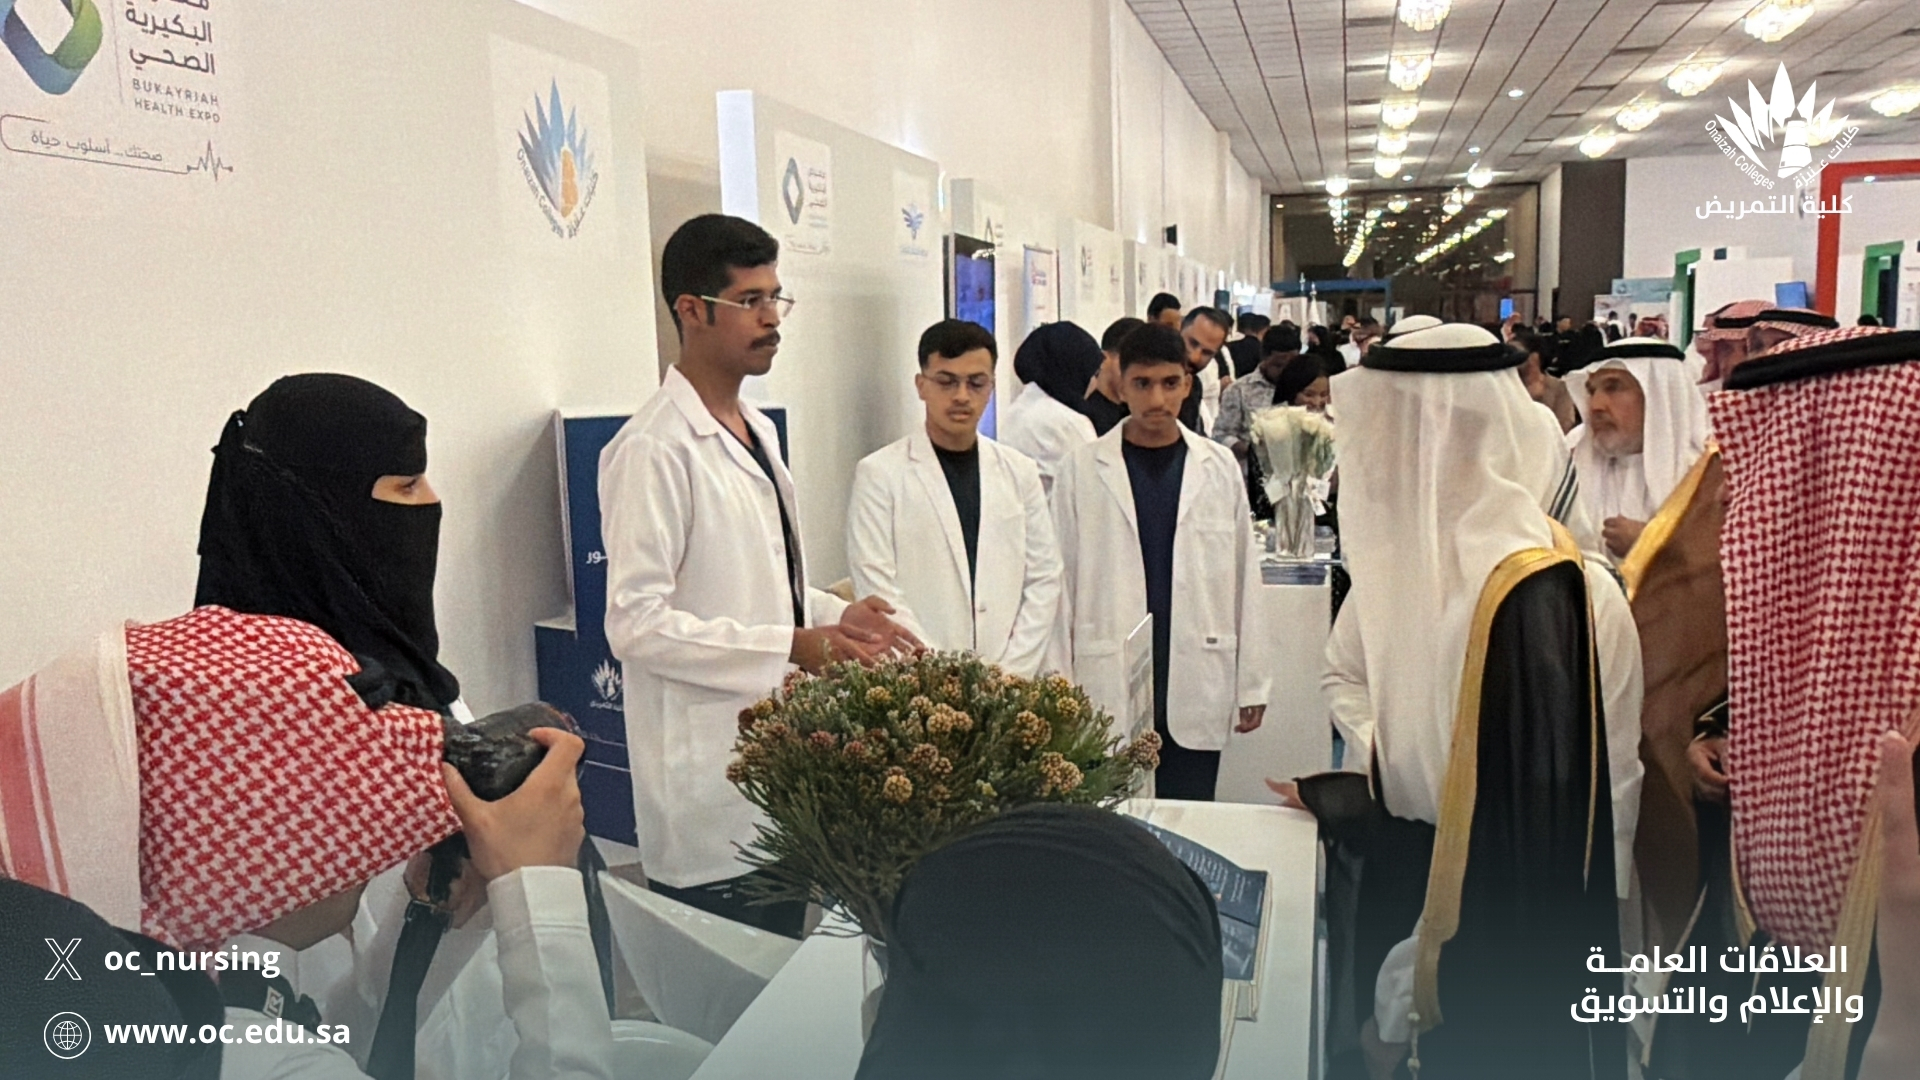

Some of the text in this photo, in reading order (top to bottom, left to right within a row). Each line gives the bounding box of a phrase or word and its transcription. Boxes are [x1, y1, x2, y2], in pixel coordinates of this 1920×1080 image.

[126, 1, 212, 46] البكيرية
[129, 48, 215, 75] الصحي
[133, 78, 219, 106] BUKAYRIAH
[134, 98, 221, 123] HEALTH EXPO
[31, 130, 60, 149] حياة
[66, 138, 110, 155] أسلوب
